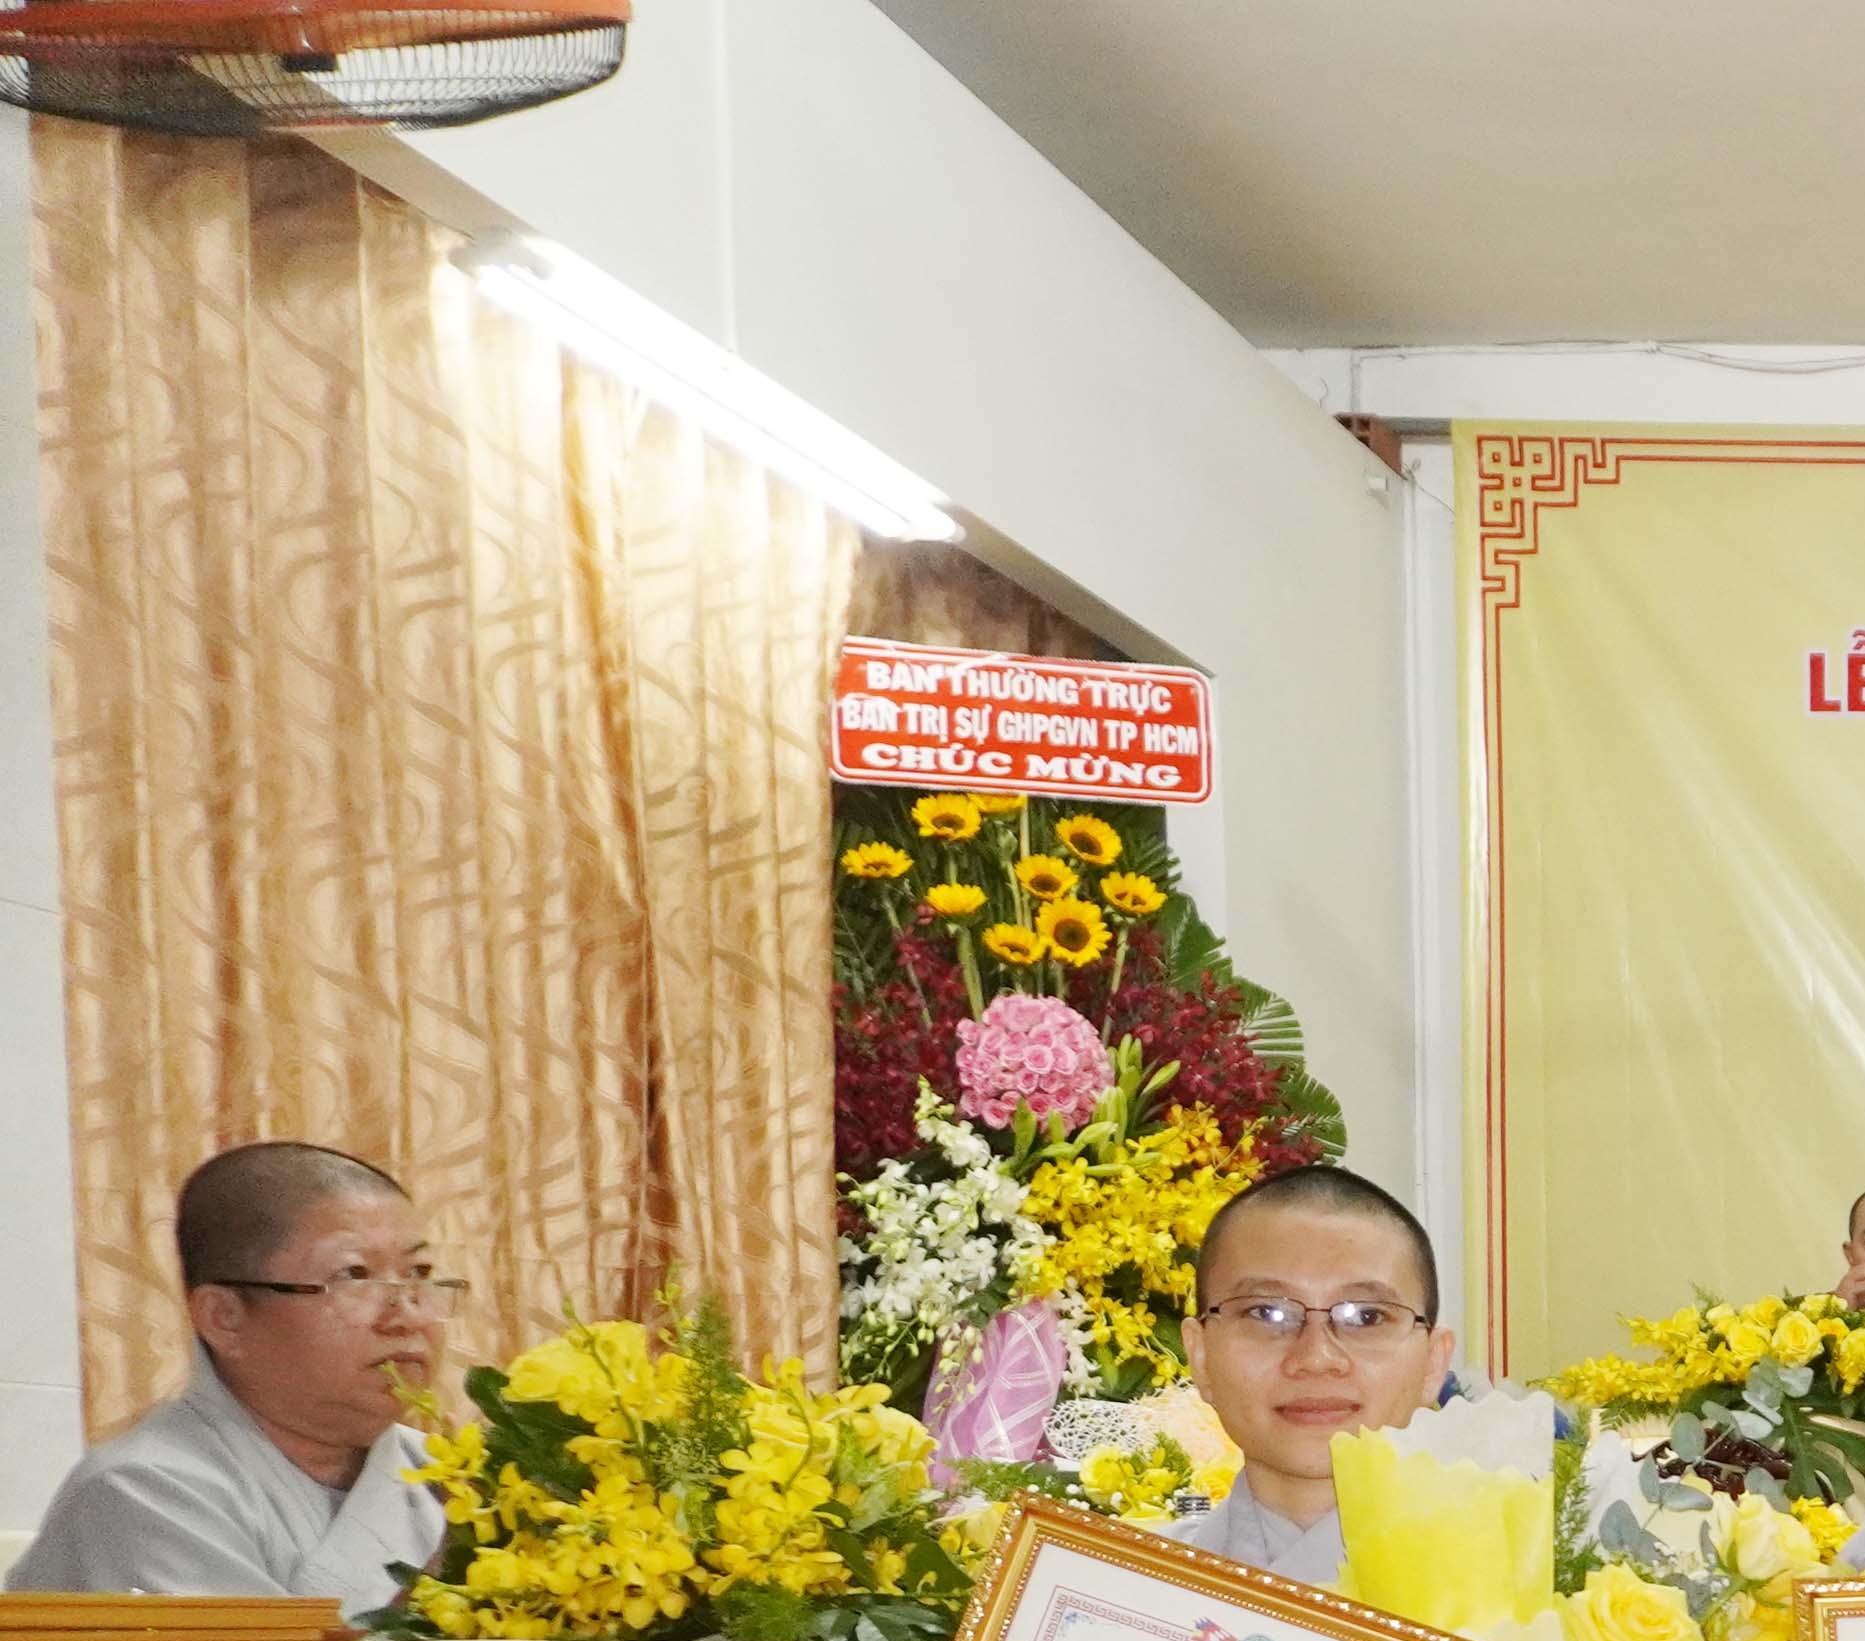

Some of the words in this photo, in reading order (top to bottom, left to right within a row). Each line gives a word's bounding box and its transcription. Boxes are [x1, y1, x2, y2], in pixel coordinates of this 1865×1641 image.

[866, 661, 941, 694] BAN
[945, 662, 1080, 706] THƯỜNG
[1083, 674, 1173, 717] TRỰC
[841, 698, 899, 733] BAN
[902, 702, 950, 743] TRỊ
[954, 703, 993, 745] SỰ
[997, 710, 1099, 749] GHPGVN
[1103, 719, 1139, 751] TP
[1143, 724, 1200, 757] HCM
[861, 741, 1014, 777] CHÚC
[1025, 752, 1183, 788] MỪNG
